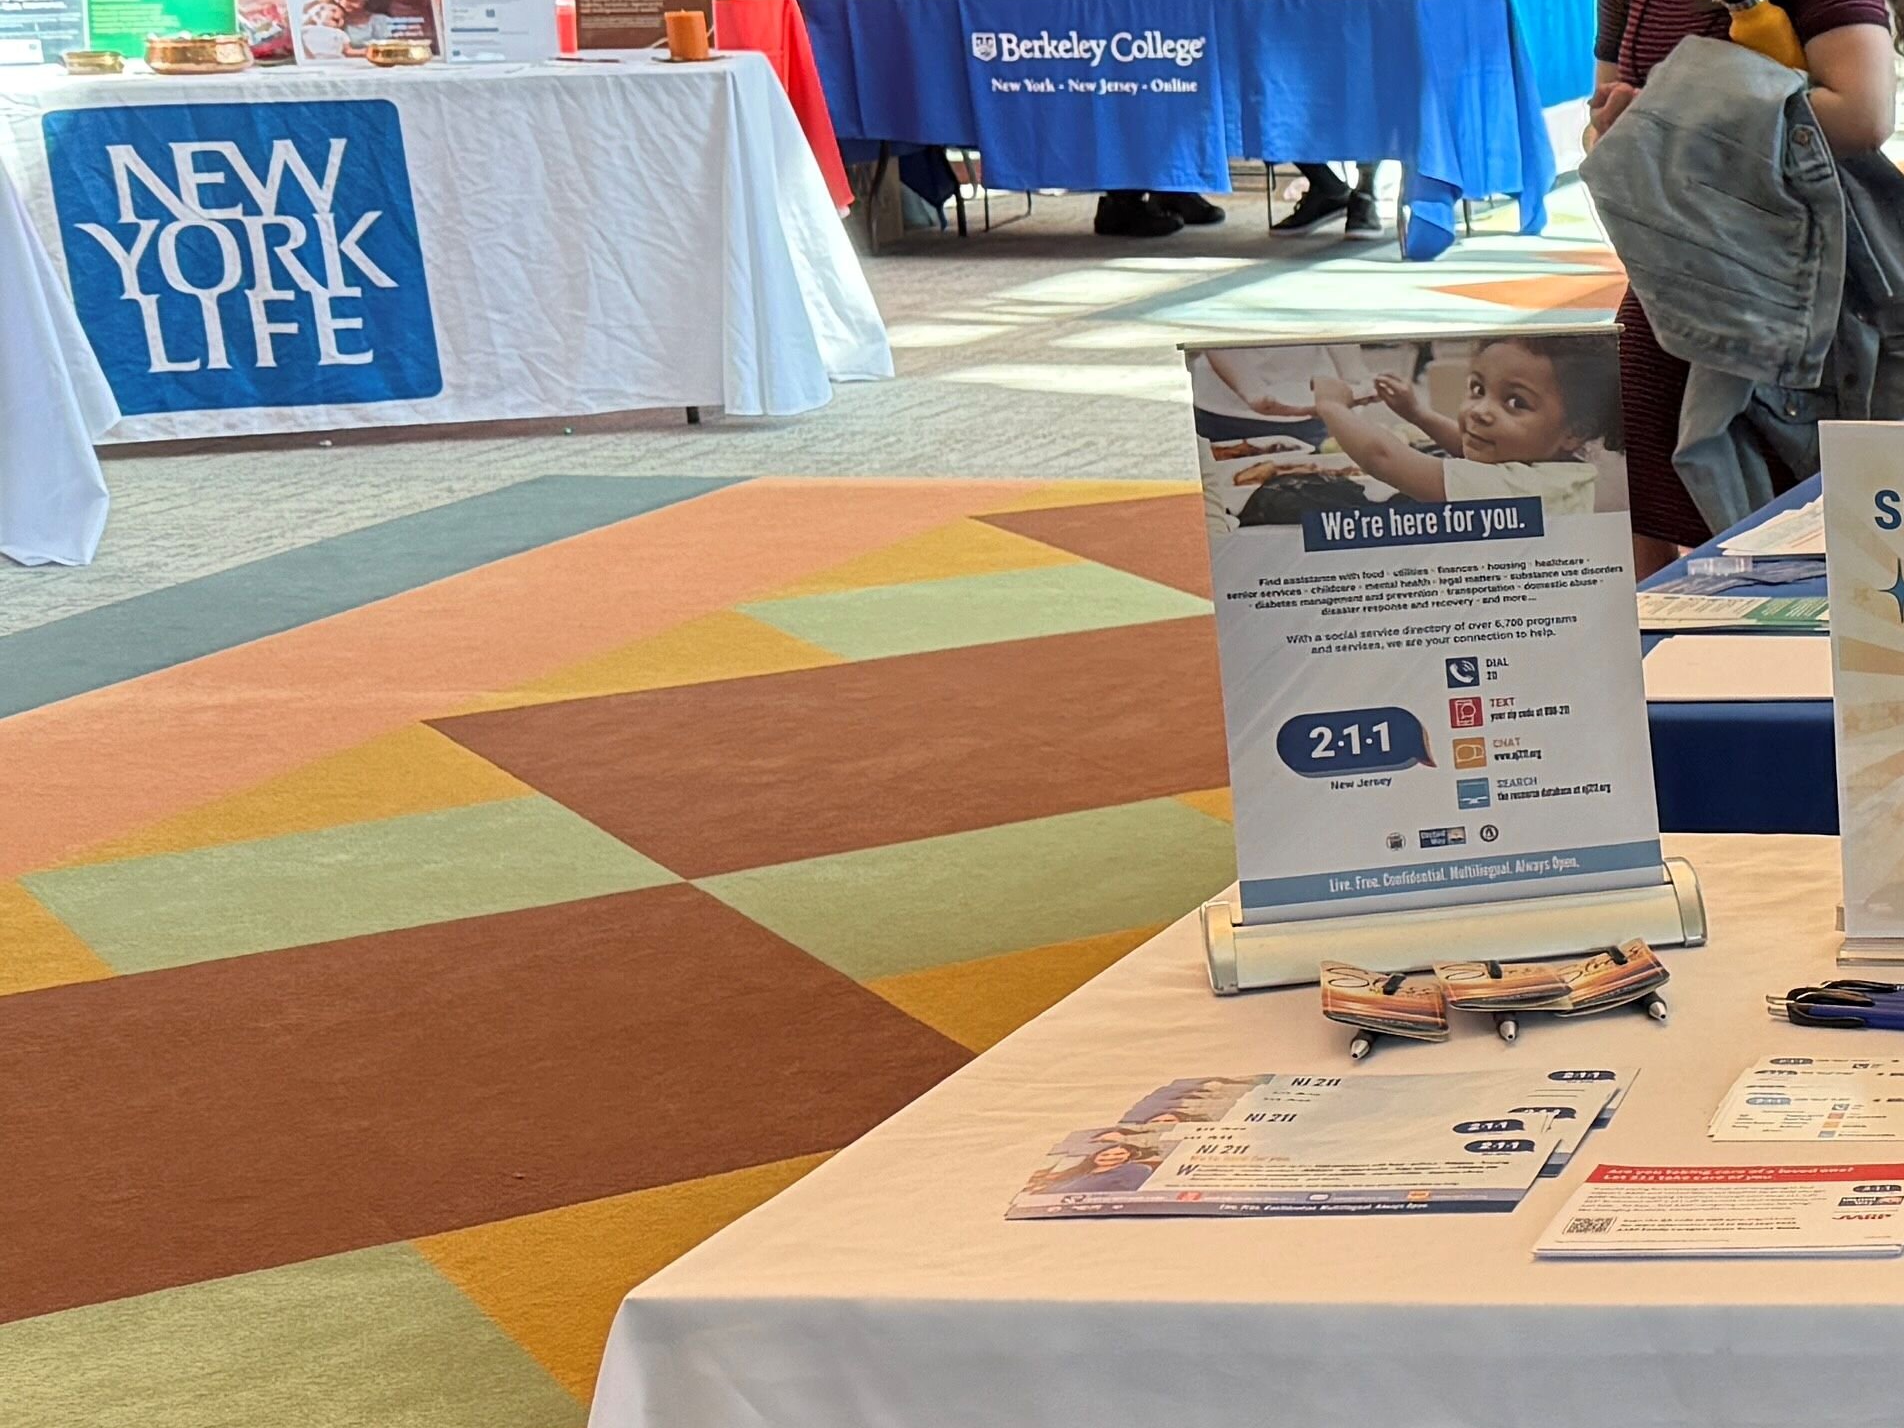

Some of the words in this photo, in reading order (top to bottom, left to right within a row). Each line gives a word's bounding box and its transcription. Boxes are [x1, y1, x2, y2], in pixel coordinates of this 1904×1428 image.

[999, 30, 1106, 67] Berkeley
[1111, 30, 1203, 67] College
[991, 78, 1021, 92] New
[1024, 77, 1056, 92] York
[1068, 78, 1097, 93] New
[1100, 78, 1138, 96] Jersey
[1150, 77, 1198, 92] Online
[105, 138, 347, 225] NEW
[75, 210, 398, 301] YORK
[140, 288, 374, 373] LIFE
[1389, 508, 1438, 536] here
[1443, 504, 1475, 533] for
[1480, 506, 1526, 537] you.
[1286, 634, 1312, 645] With
[1314, 634, 1322, 642] a
[1324, 630, 1358, 642] social
[1360, 628, 1400, 639] service
[1402, 622, 1451, 636] directory
[1454, 622, 1465, 631] of
[1468, 621, 1492, 630] over
[1526, 615, 1578, 627] programs
[1311, 645, 1332, 655] and
[1387, 640, 1402, 649] we
[1425, 636, 1450, 647] your
[1453, 631, 1514, 644] connection
[1516, 630, 1528, 639] to
[1485, 657, 1509, 668] DIAL
[1490, 697, 1516, 707] TEXT
[1493, 737, 1521, 748] CHAT
[1330, 780, 1355, 789] New
[1357, 777, 1392, 788] Jersey
[1496, 776, 1538, 788] SEARCH
[1515, 858, 1551, 874] Always
[1291, 1078, 1311, 1086] NJ
[1313, 1078, 1342, 1087] 211
[1244, 1113, 1266, 1122] NJ
[1268, 1113, 1297, 1122] 211
[1197, 1145, 1219, 1154] NJ
[1220, 1144, 1250, 1155] 211
